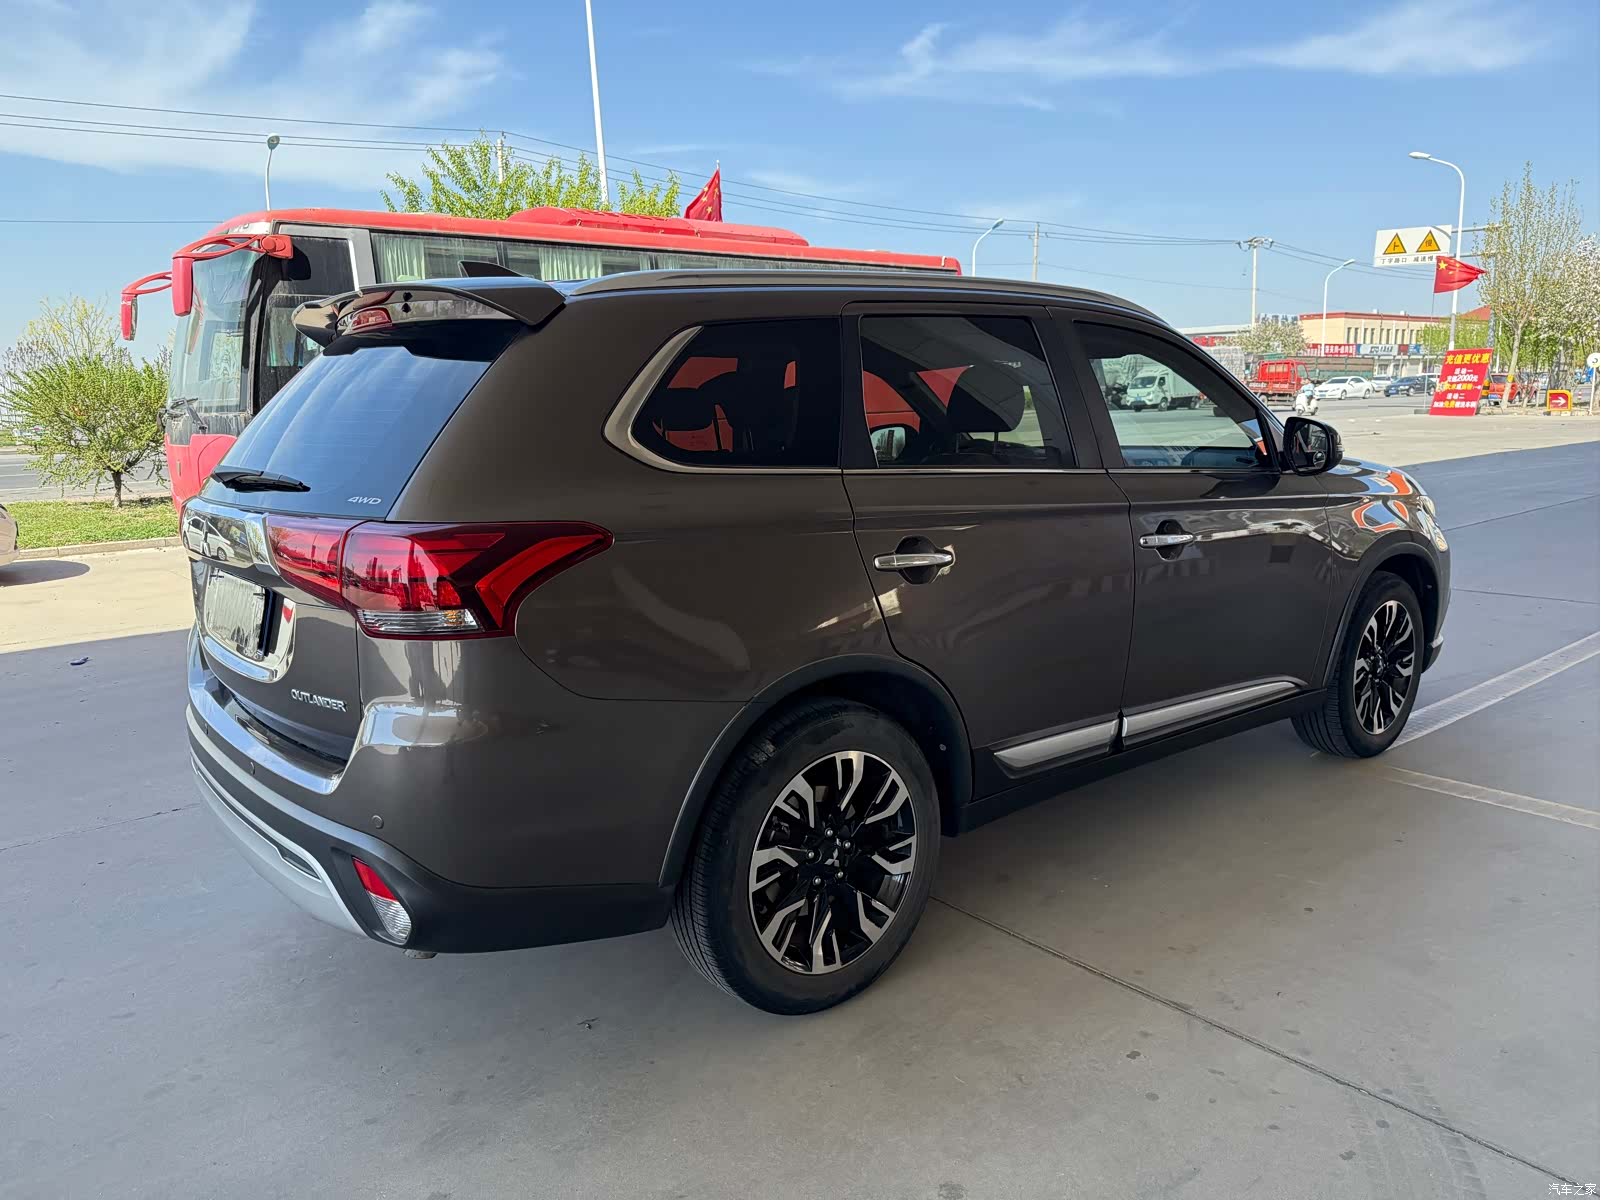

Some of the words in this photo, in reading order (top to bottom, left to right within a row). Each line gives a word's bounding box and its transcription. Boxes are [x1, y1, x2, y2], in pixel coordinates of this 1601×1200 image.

[1445, 352, 1491, 365] 充值更优惠
[347, 496, 382, 505] 4WD
[290, 688, 347, 713] OUTLANDER
